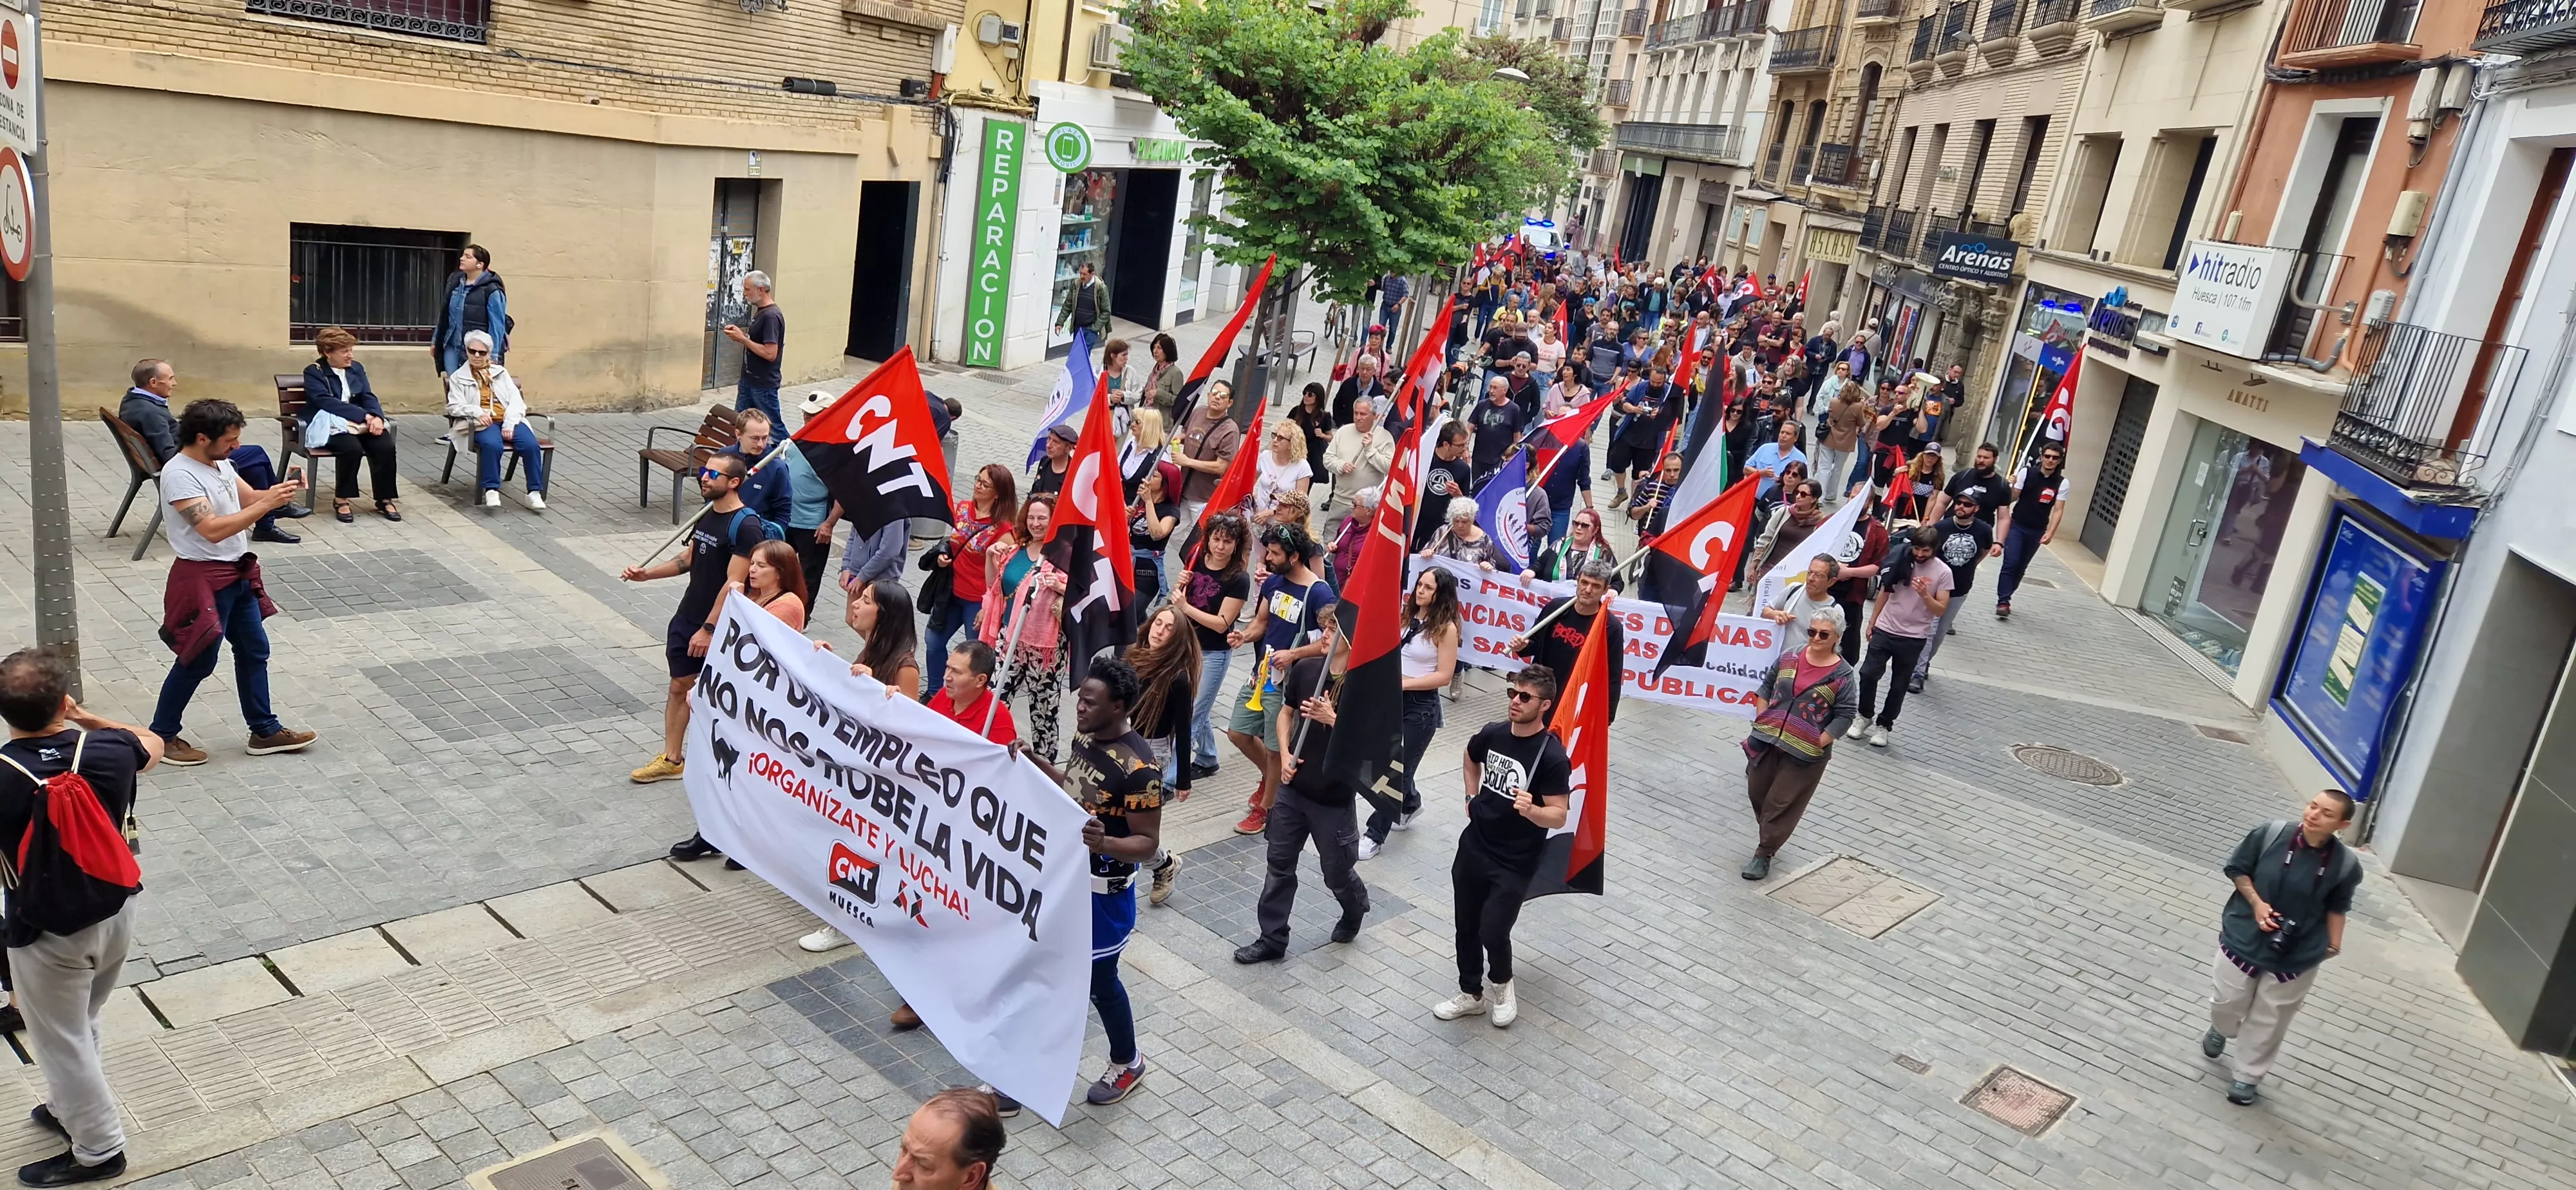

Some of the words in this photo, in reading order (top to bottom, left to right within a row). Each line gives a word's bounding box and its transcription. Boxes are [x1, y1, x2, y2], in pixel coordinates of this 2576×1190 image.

[17, 101, 24, 119] DE
[1056, 128, 1081, 139] PLAZA
[1056, 157, 1077, 167] MOVIL
[973, 128, 1014, 361] REPARACION
[1809, 230, 1855, 258] ASCASO
[1940, 245, 2013, 270] Arenas
[1938, 263, 1959, 272] CENTRO
[1960, 265, 1979, 275] ÓPTICO
[1984, 270, 2009, 279] AUDITIVO
[2199, 250, 2262, 290] hitradio
[2192, 286, 2218, 305] Huesca
[845, 394, 934, 498] CNT
[1621, 668, 1758, 708] PÚBLICA
[719, 616, 780, 692] POR
[783, 667, 830, 728] UN
[831, 704, 965, 809] EMPLEO
[971, 786, 1047, 874] QUE
[697, 663, 738, 720] NO
[745, 696, 815, 768] NOS
[815, 747, 916, 835] ROBE
[914, 804, 952, 873] LA
[962, 838, 1043, 942] VIDA
[836, 857, 873, 891] CNT
[884, 833, 896, 859] Y
[899, 845, 971, 921] LUCHA!
